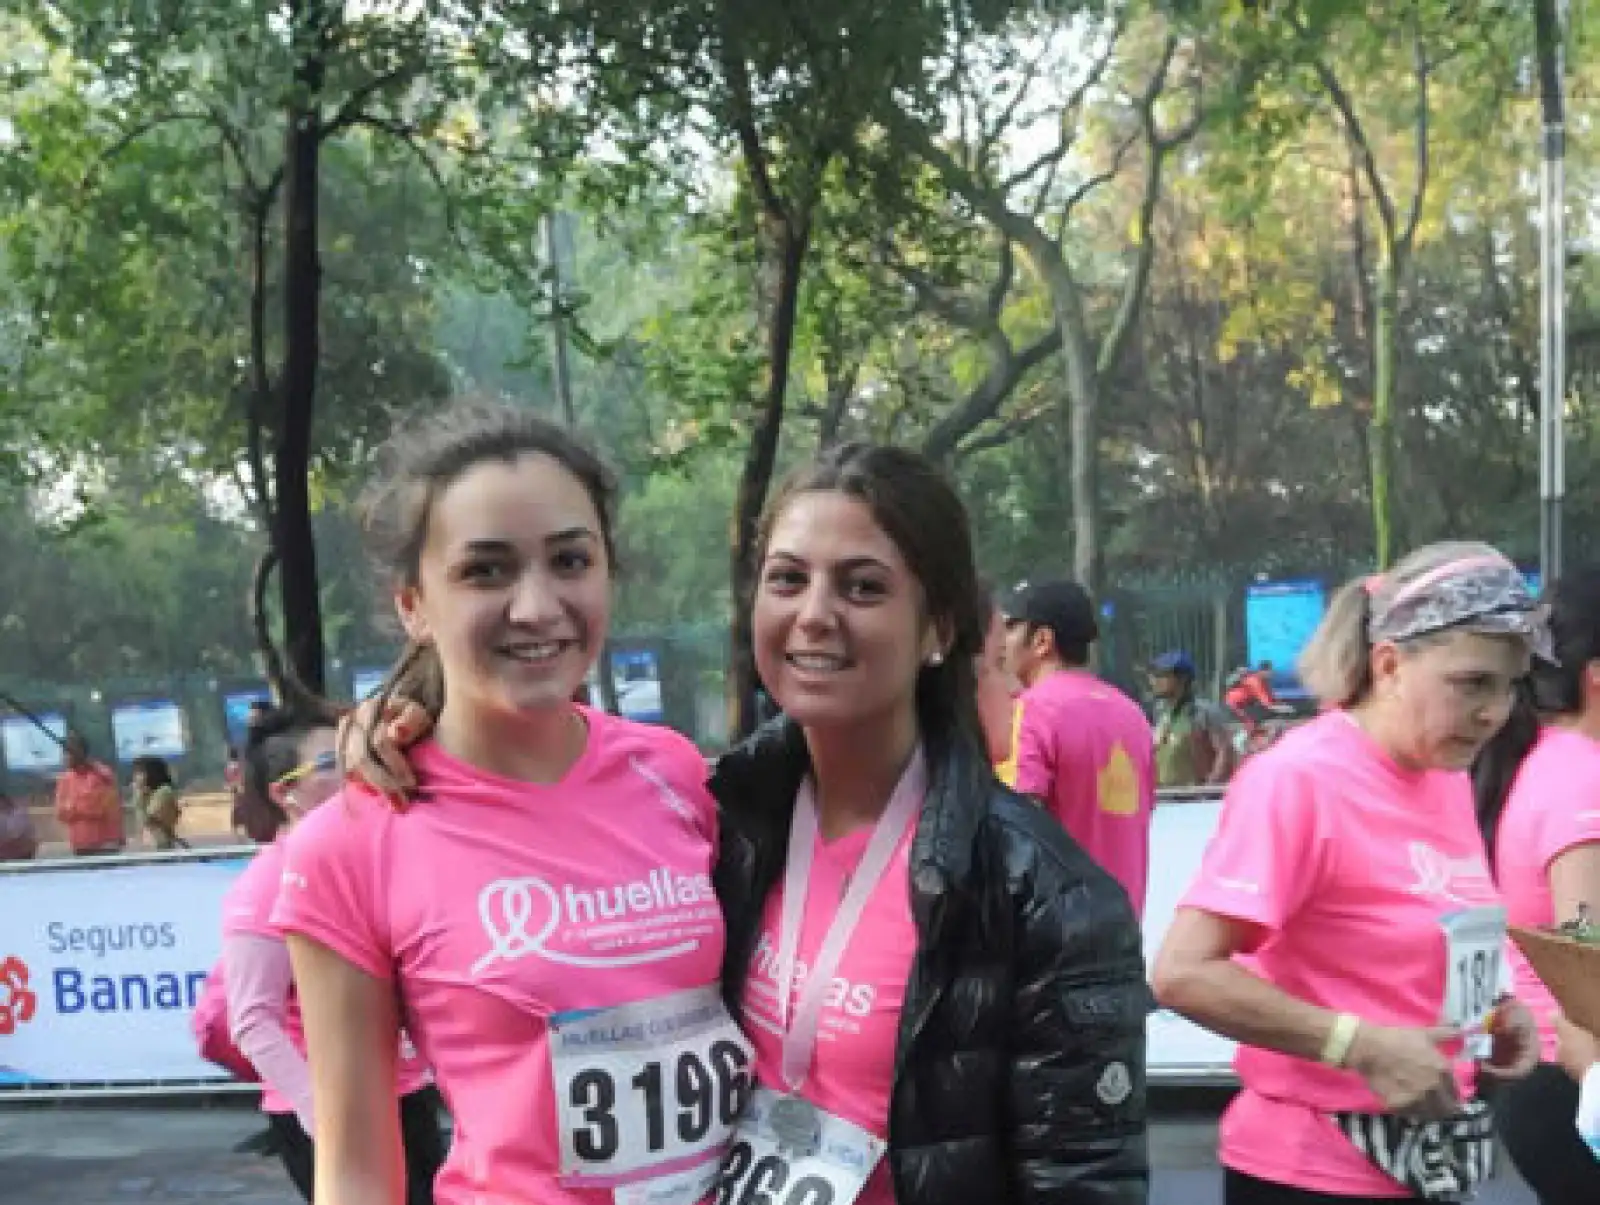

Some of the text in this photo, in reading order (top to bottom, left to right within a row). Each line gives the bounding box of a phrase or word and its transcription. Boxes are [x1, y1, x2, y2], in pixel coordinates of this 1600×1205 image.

[564, 866, 717, 923] huellas
[47, 921, 177, 957] Seguros
[569, 1040, 758, 1163] 3196
